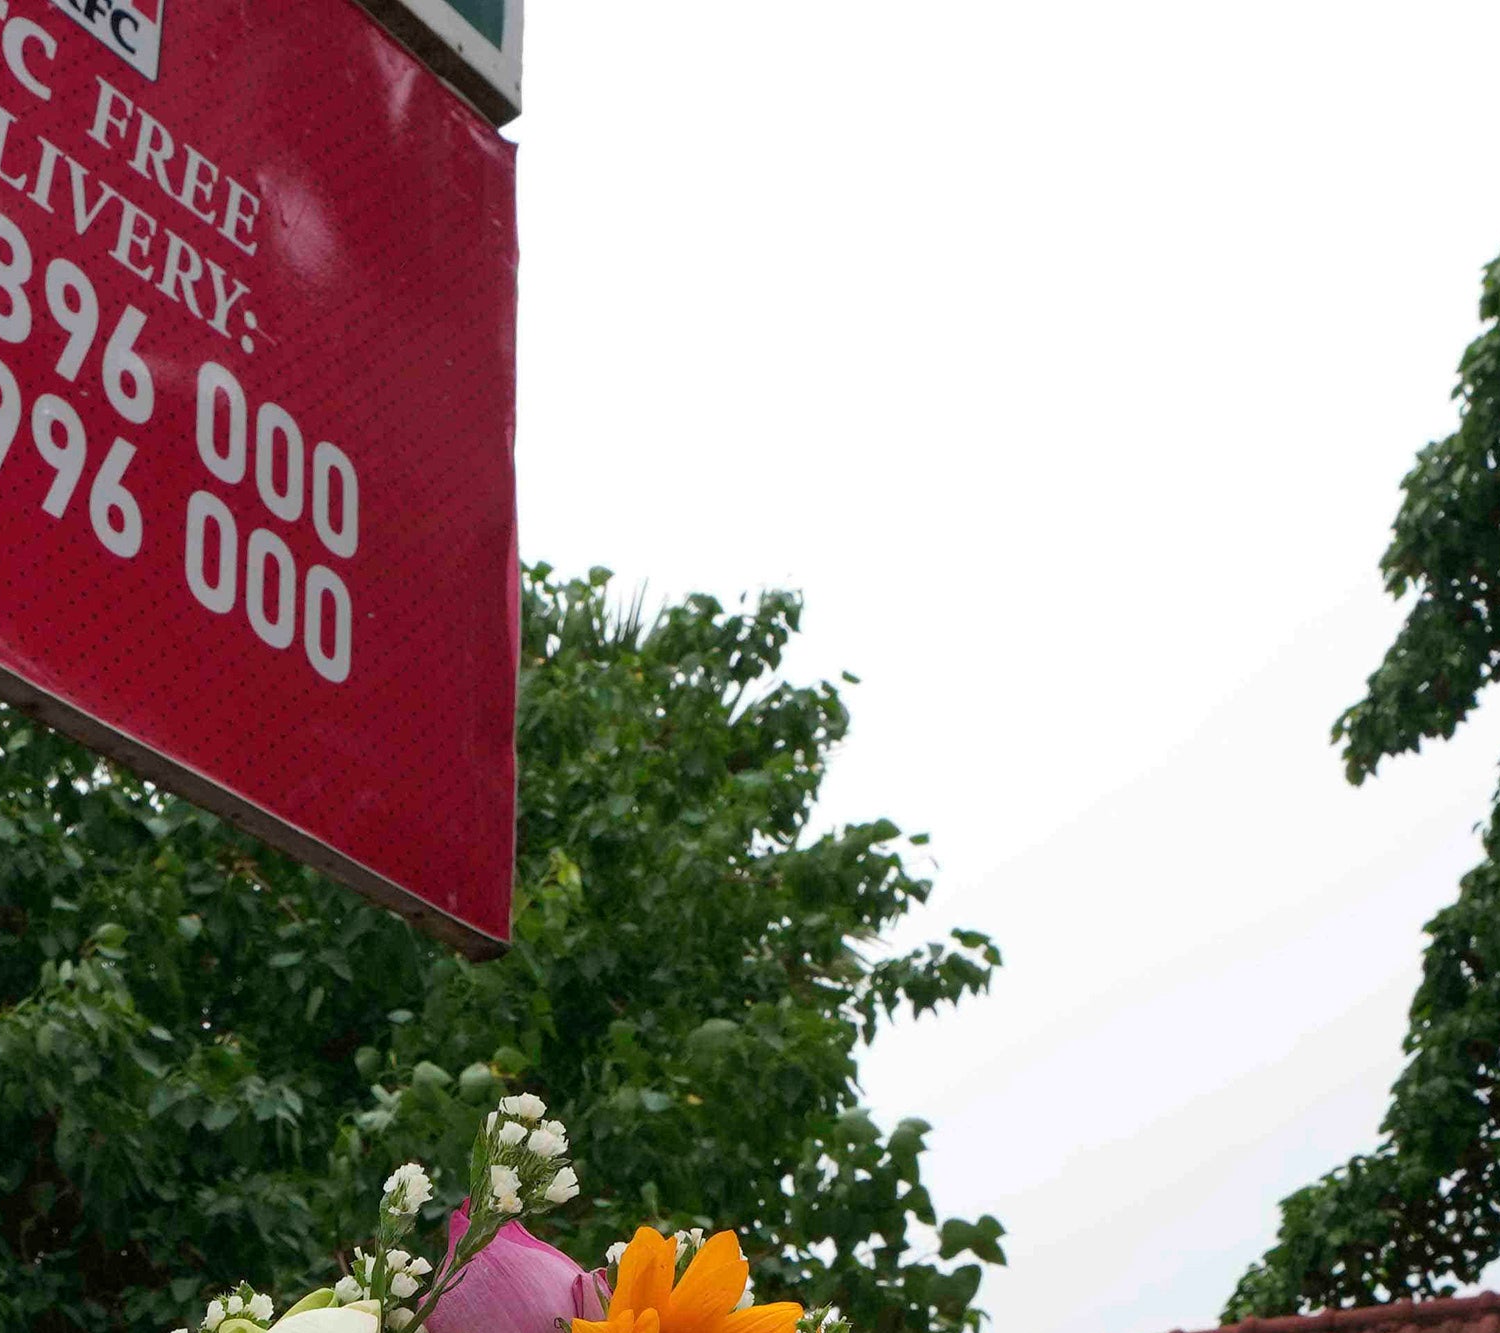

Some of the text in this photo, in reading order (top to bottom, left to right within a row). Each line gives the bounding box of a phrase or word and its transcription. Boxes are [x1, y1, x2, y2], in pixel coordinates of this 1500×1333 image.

[85, 76, 260, 256] FREE
[196, 361, 359, 558] 000
[185, 490, 352, 684] 000
